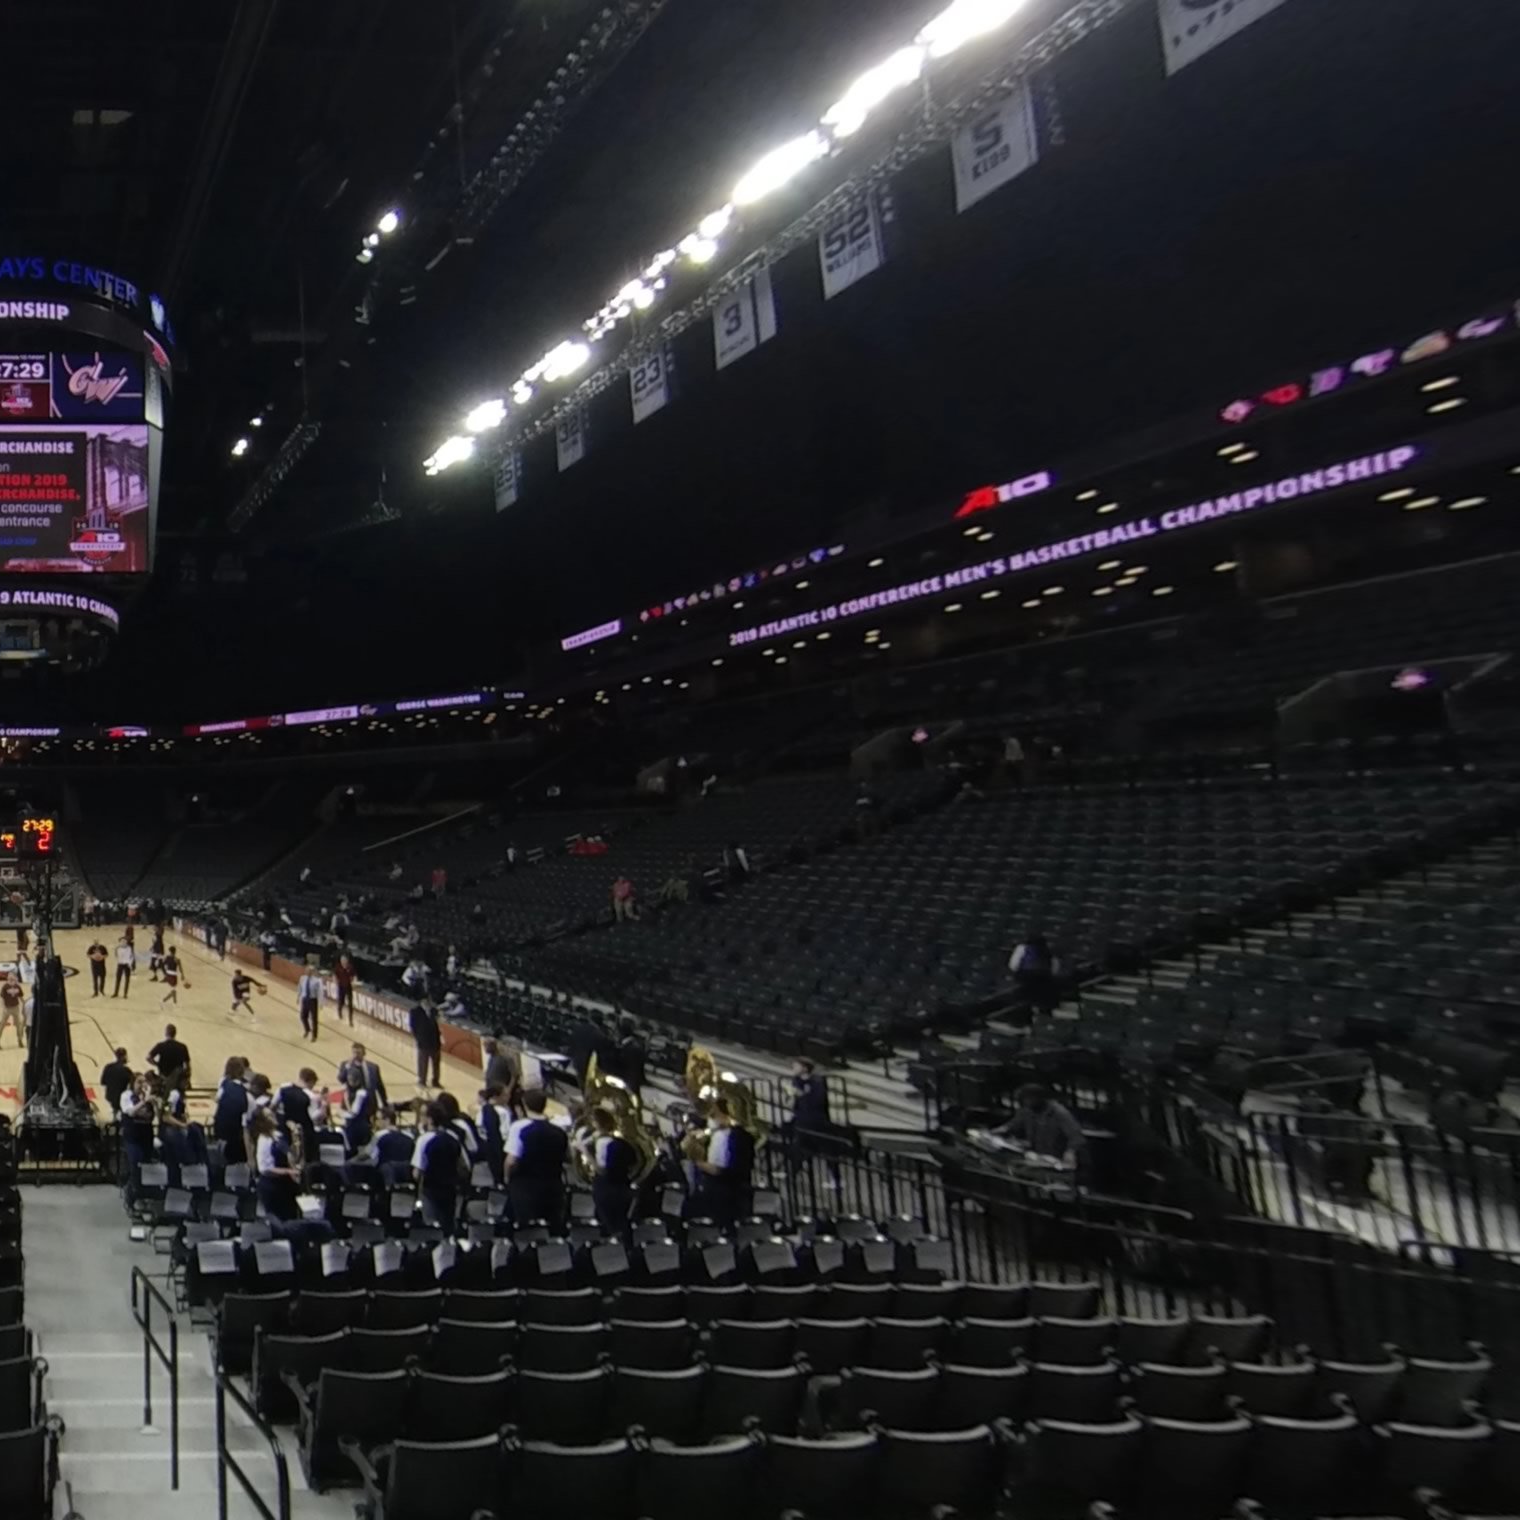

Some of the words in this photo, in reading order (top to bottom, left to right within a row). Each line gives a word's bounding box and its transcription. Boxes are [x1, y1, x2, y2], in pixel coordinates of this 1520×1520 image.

[972, 111, 1001, 157] 5
[824, 205, 871, 258] 52
[53, 260, 140, 302] CENTER
[723, 303, 742, 337] 3
[633, 355, 661, 394] 23
[34, 474, 68, 487] 2019
[954, 469, 1052, 519] A10
[0, 503, 63, 514] concourse
[730, 629, 758, 647] 2019
[759, 612, 819, 640] ATLANTIC
[820, 607, 837, 623] 10
[839, 575, 941, 615] CONFERENCE
[945, 560, 1006, 590] MEN'S
[1009, 518, 1158, 572] BASKETBALL
[1160, 445, 1418, 532] CHAMPIONSHIP
[12, 590, 75, 608] ATLANTIC
[76, 596, 89, 611] 10
[22, 819, 54, 832] 27:29
[37, 831, 50, 850] 2
